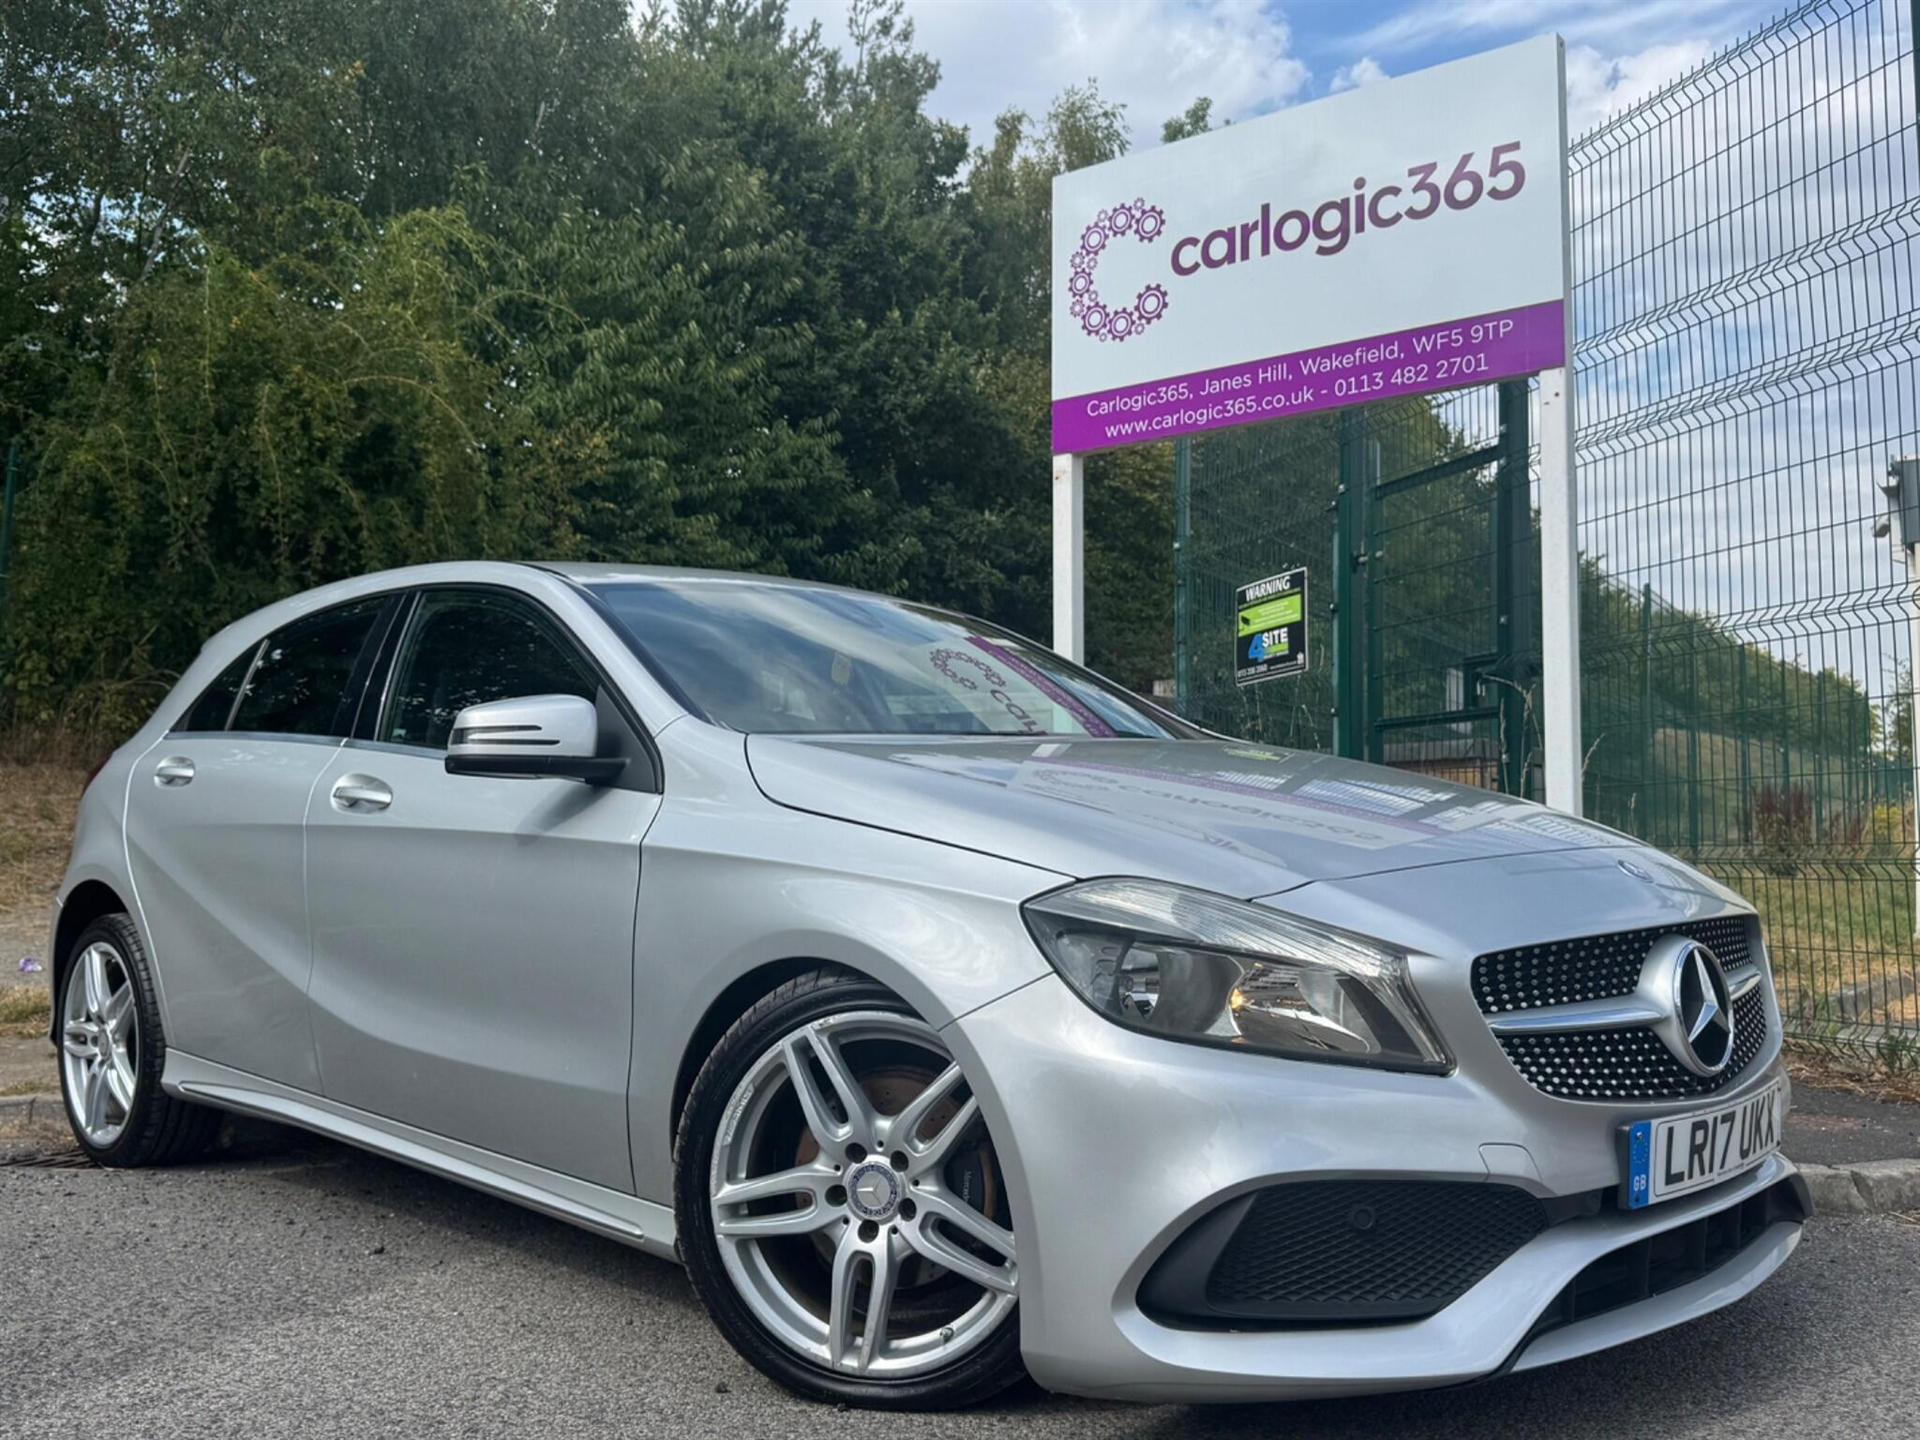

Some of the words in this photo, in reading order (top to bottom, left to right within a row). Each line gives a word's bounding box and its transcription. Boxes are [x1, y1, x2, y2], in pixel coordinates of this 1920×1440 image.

[1171, 141, 1525, 276] carlogic365
[1087, 382, 1193, 417] Carlogic365,
[1200, 374, 1252, 395] Janes
[1258, 361, 1293, 385] Hill,
[1300, 341, 1404, 376] Wakefield,
[1413, 329, 1463, 354] WF5
[1470, 319, 1514, 343] 9TP
[1105, 386, 1313, 438] www.carlogic365.co.uk
[1334, 372, 1384, 397] 0113
[1390, 363, 1429, 386] 482
[1436, 353, 1489, 378] 2701
[1245, 575, 1291, 602] WARNING
[1633, 1173, 1647, 1192] GB
[1665, 1110, 1737, 1186] LR17
[1739, 1089, 1776, 1161] UKX
